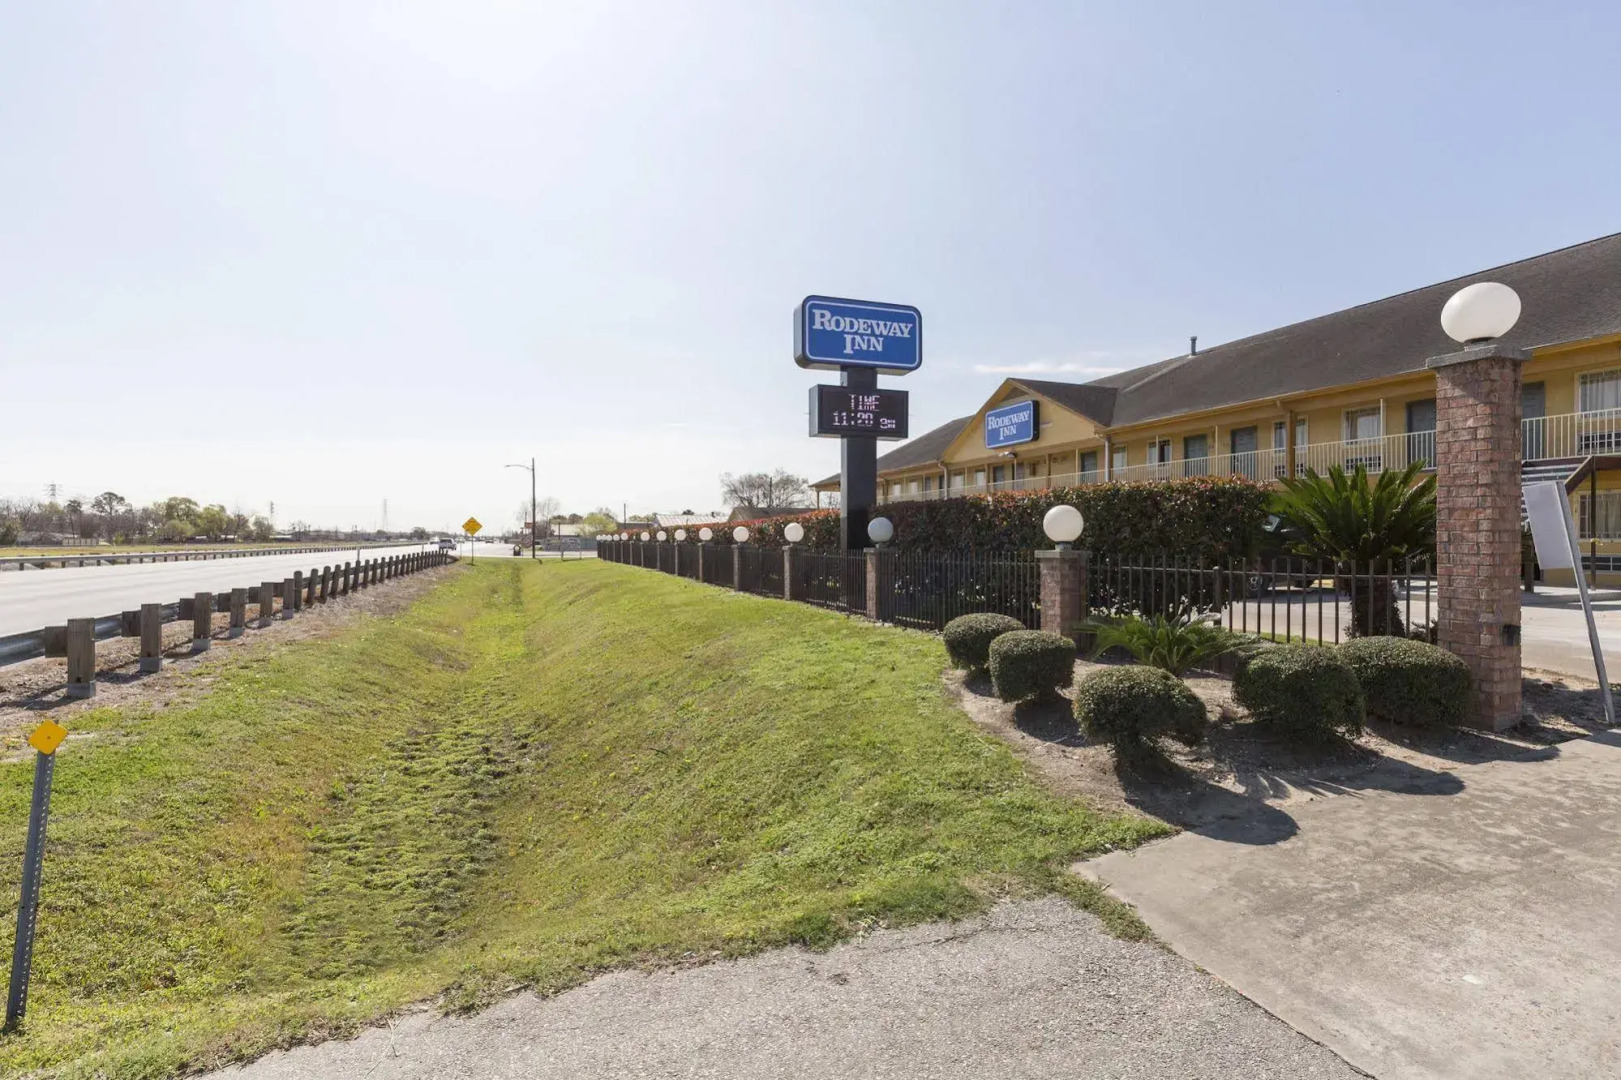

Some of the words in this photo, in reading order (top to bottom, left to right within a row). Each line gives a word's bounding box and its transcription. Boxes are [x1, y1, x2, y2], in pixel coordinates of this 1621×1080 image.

[812, 309, 913, 338] RODEWAY
[843, 334, 883, 354] INN
[848, 394, 880, 411] TIME
[987, 410, 1030, 430] RODEWAY
[999, 424, 1017, 440] INN
